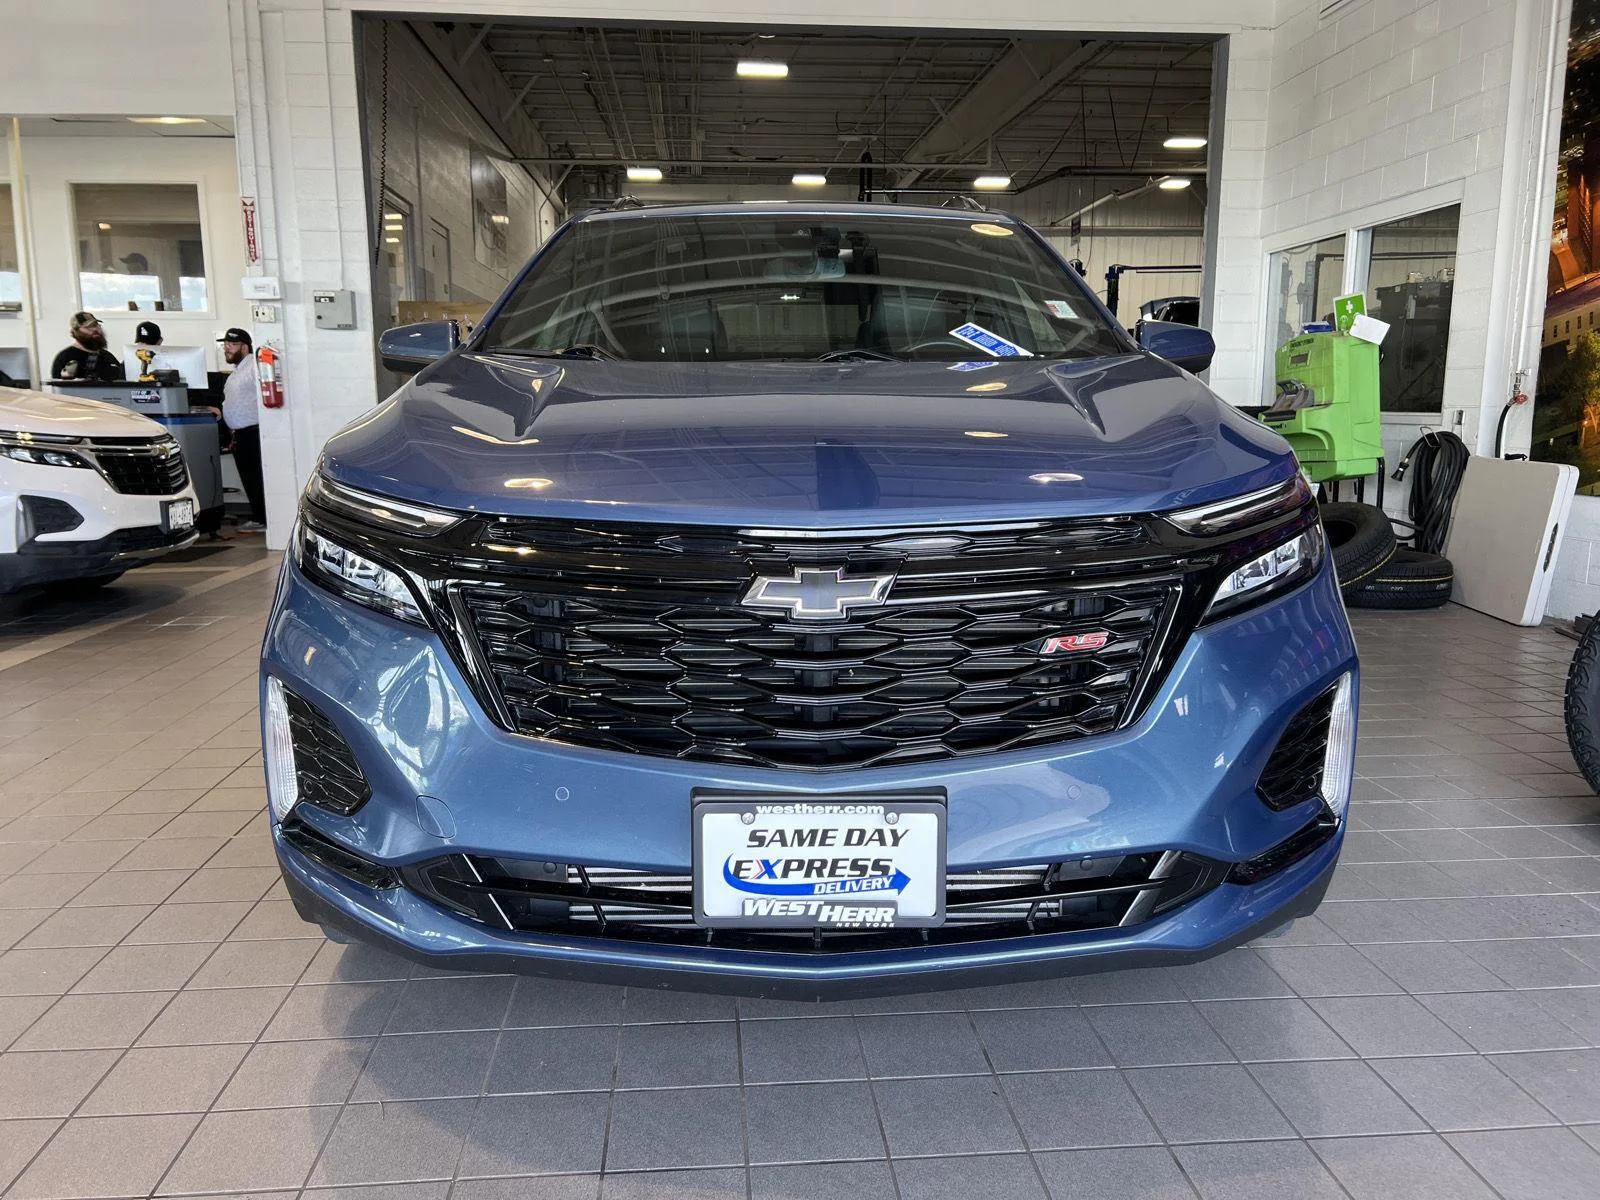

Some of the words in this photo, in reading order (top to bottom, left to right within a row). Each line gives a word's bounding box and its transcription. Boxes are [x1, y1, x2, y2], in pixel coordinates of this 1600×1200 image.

[1039, 631, 1109, 654] RS
[756, 803, 884, 814] westherr.com
[747, 828, 838, 848] SAME
[843, 828, 910, 847] DAY
[732, 858, 893, 880] EXPRESS
[813, 876, 894, 895] DELIVERY
